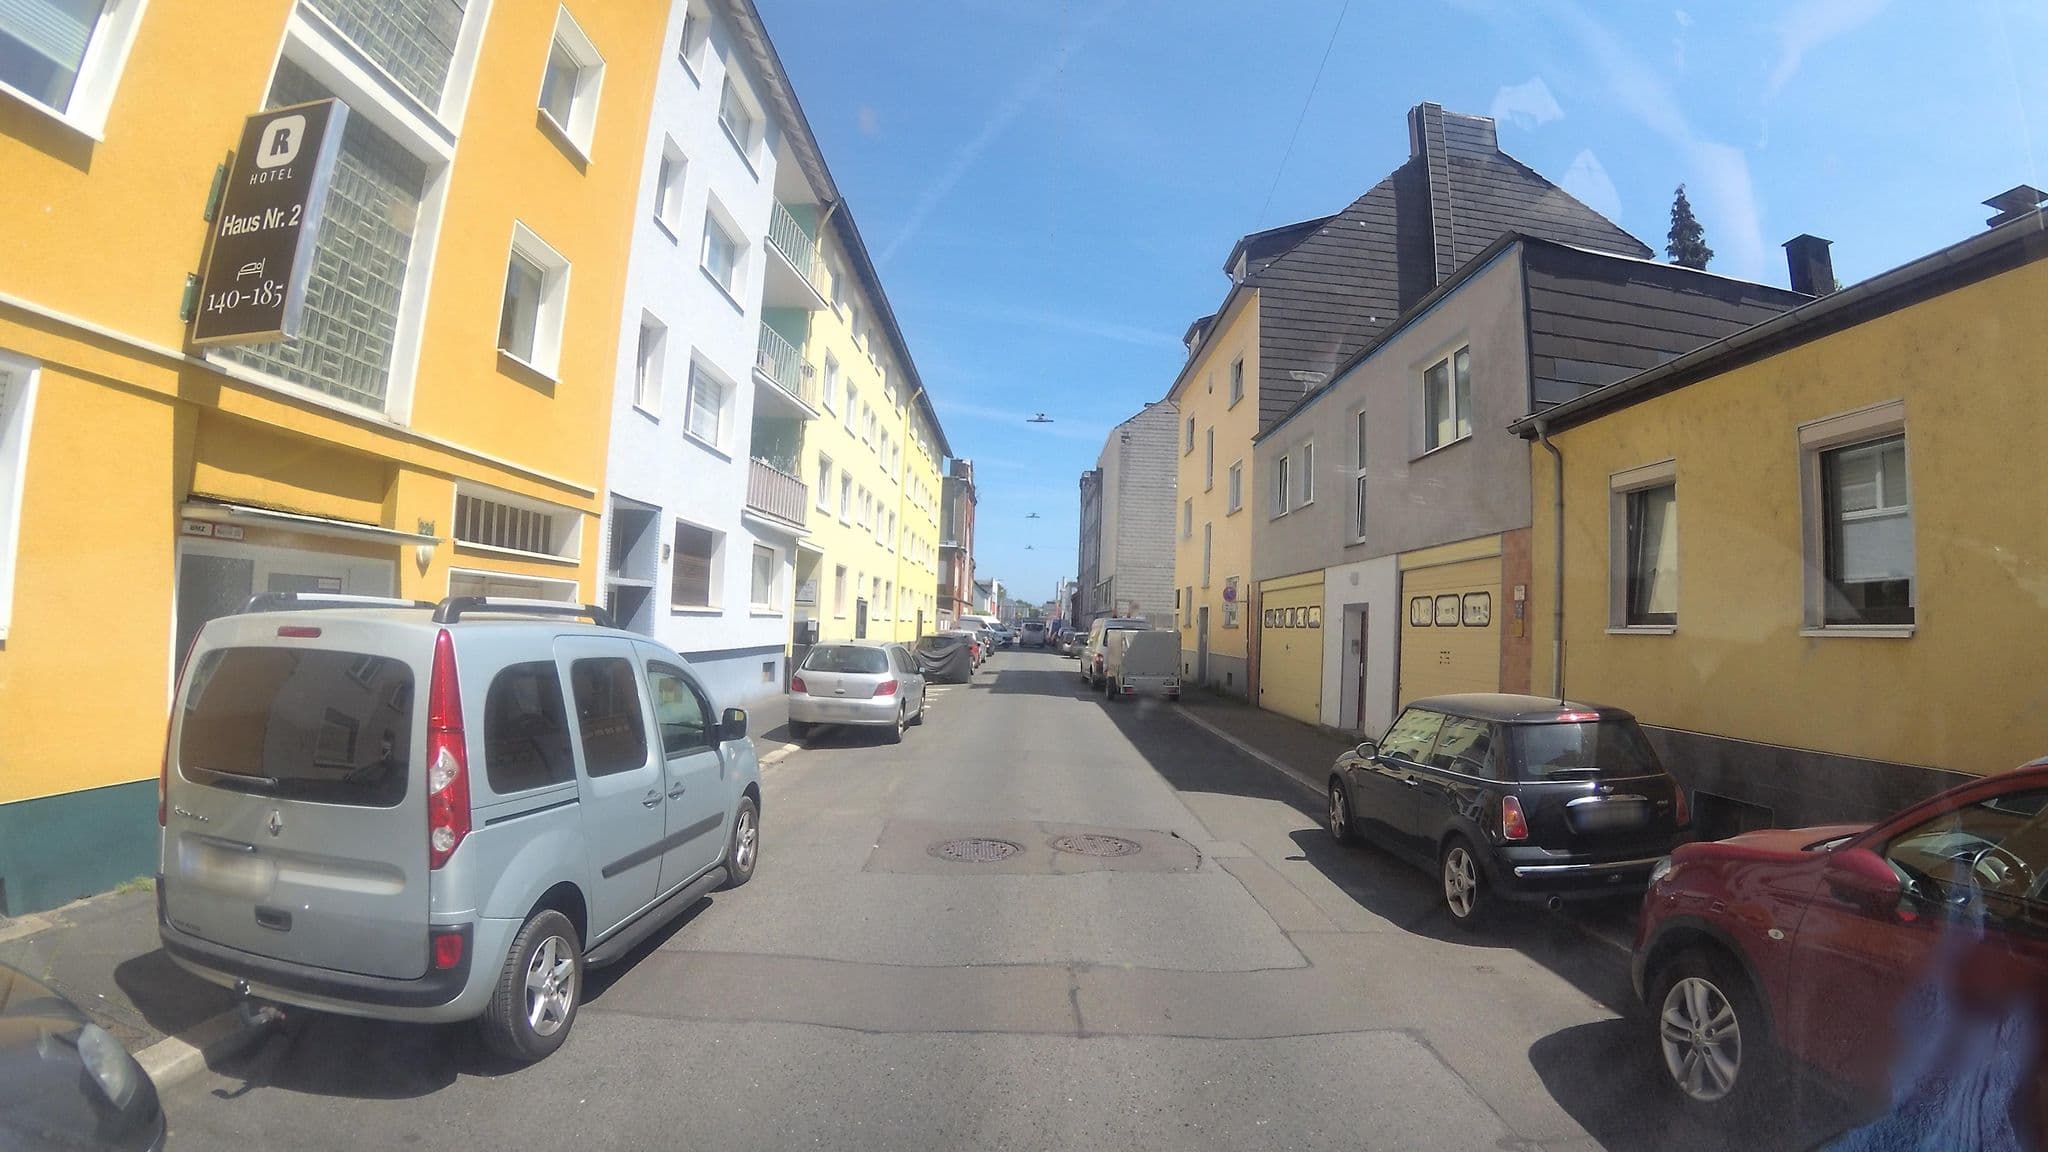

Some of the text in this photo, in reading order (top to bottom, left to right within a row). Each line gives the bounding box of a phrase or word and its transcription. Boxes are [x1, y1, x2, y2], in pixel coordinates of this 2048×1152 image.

[270, 128, 291, 157] R
[250, 168, 293, 185] HOTEL
[221, 204, 302, 237] Haus Nr. 2
[207, 279, 284, 314] 140-185
